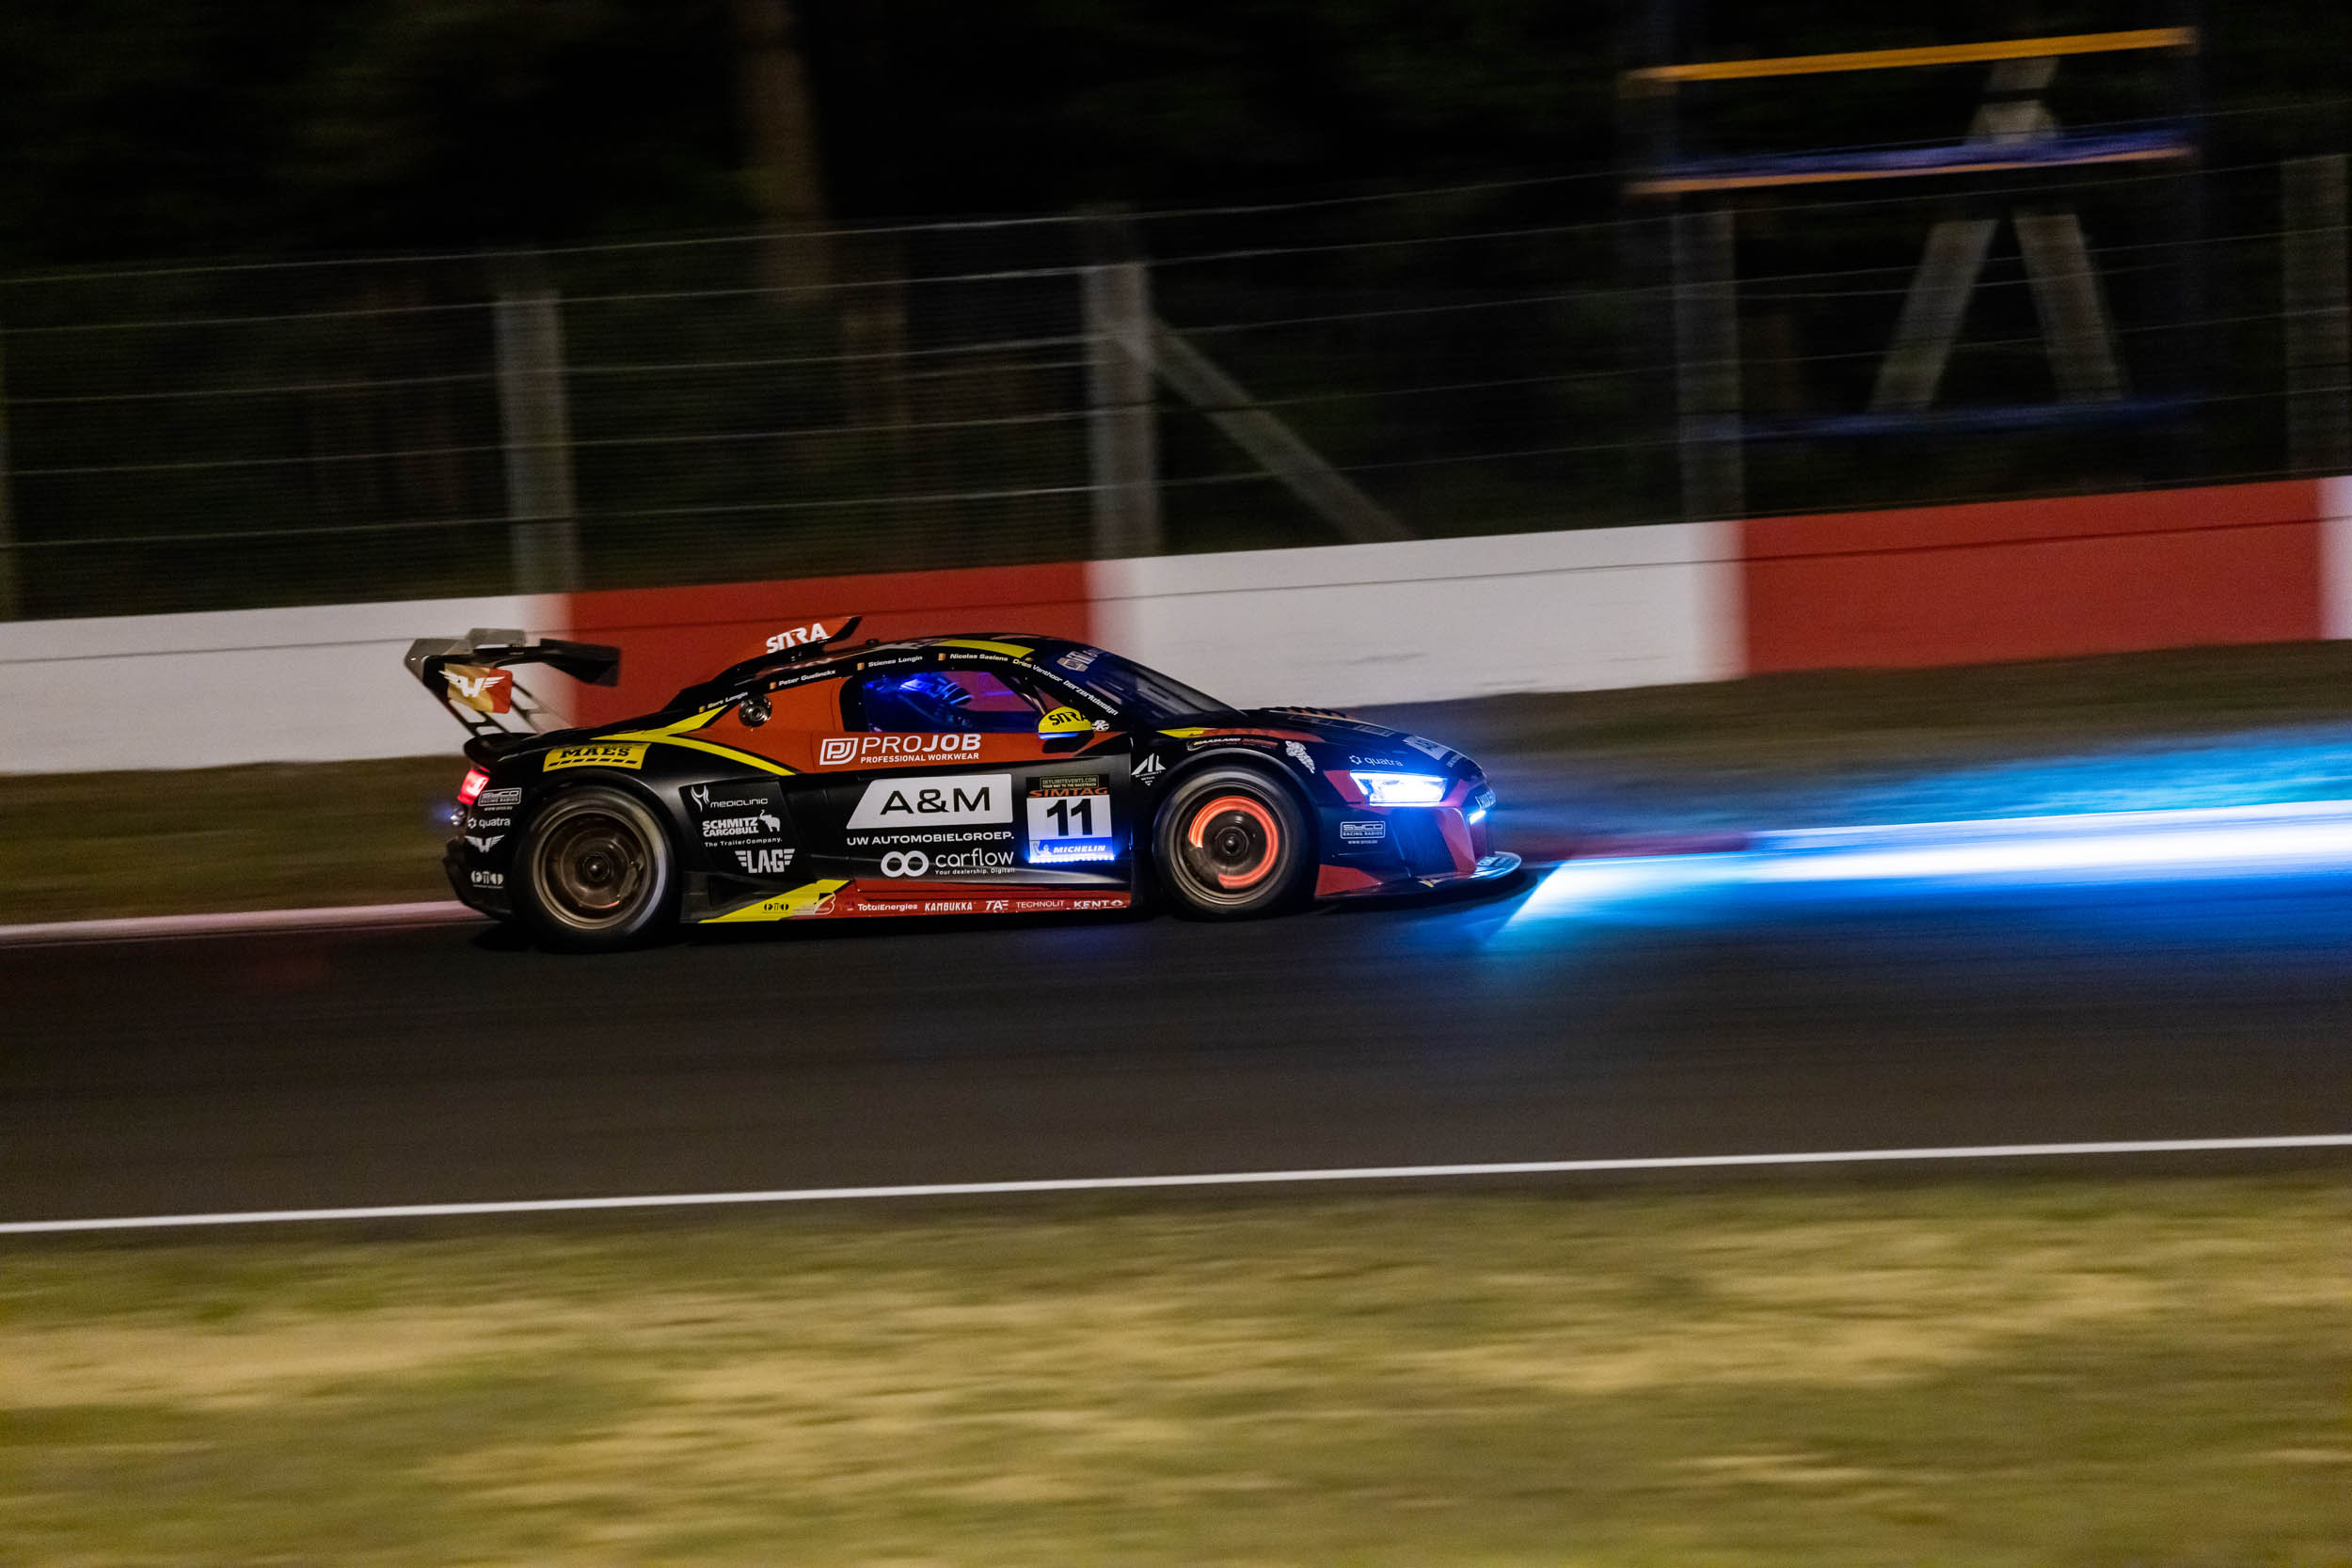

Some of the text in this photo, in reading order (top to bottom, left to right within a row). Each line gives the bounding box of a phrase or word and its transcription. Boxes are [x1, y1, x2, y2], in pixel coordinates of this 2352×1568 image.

[766, 623, 832, 654] SITRA
[868, 659, 897, 668] Stienes
[979, 654, 1009, 662] Saelens
[778, 677, 799, 687] Peter
[725, 691, 749, 703] Longin
[862, 734, 982, 754] PROJOB
[560, 748, 630, 758] MAES
[861, 752, 979, 764] PROFESSIONAL WORKWEAR
[1365, 756, 1404, 767] quatra
[1028, 787, 1107, 799] SIMTAG
[881, 787, 991, 815] A&M
[479, 817, 511, 828] quatra
[1046, 798, 1093, 836] 11
[702, 816, 758, 830] SCHMITZ
[703, 827, 759, 837] CARGOBULL
[847, 832, 1014, 846] UW AUTOMOBIELGROEP.
[1053, 845, 1106, 853] MICHELIN
[935, 847, 1014, 867] carflow
[858, 903, 918, 911] TotalEnergies
[925, 901, 973, 911] KAMBUKKA
[1016, 900, 1065, 909] TECHNOLIT
